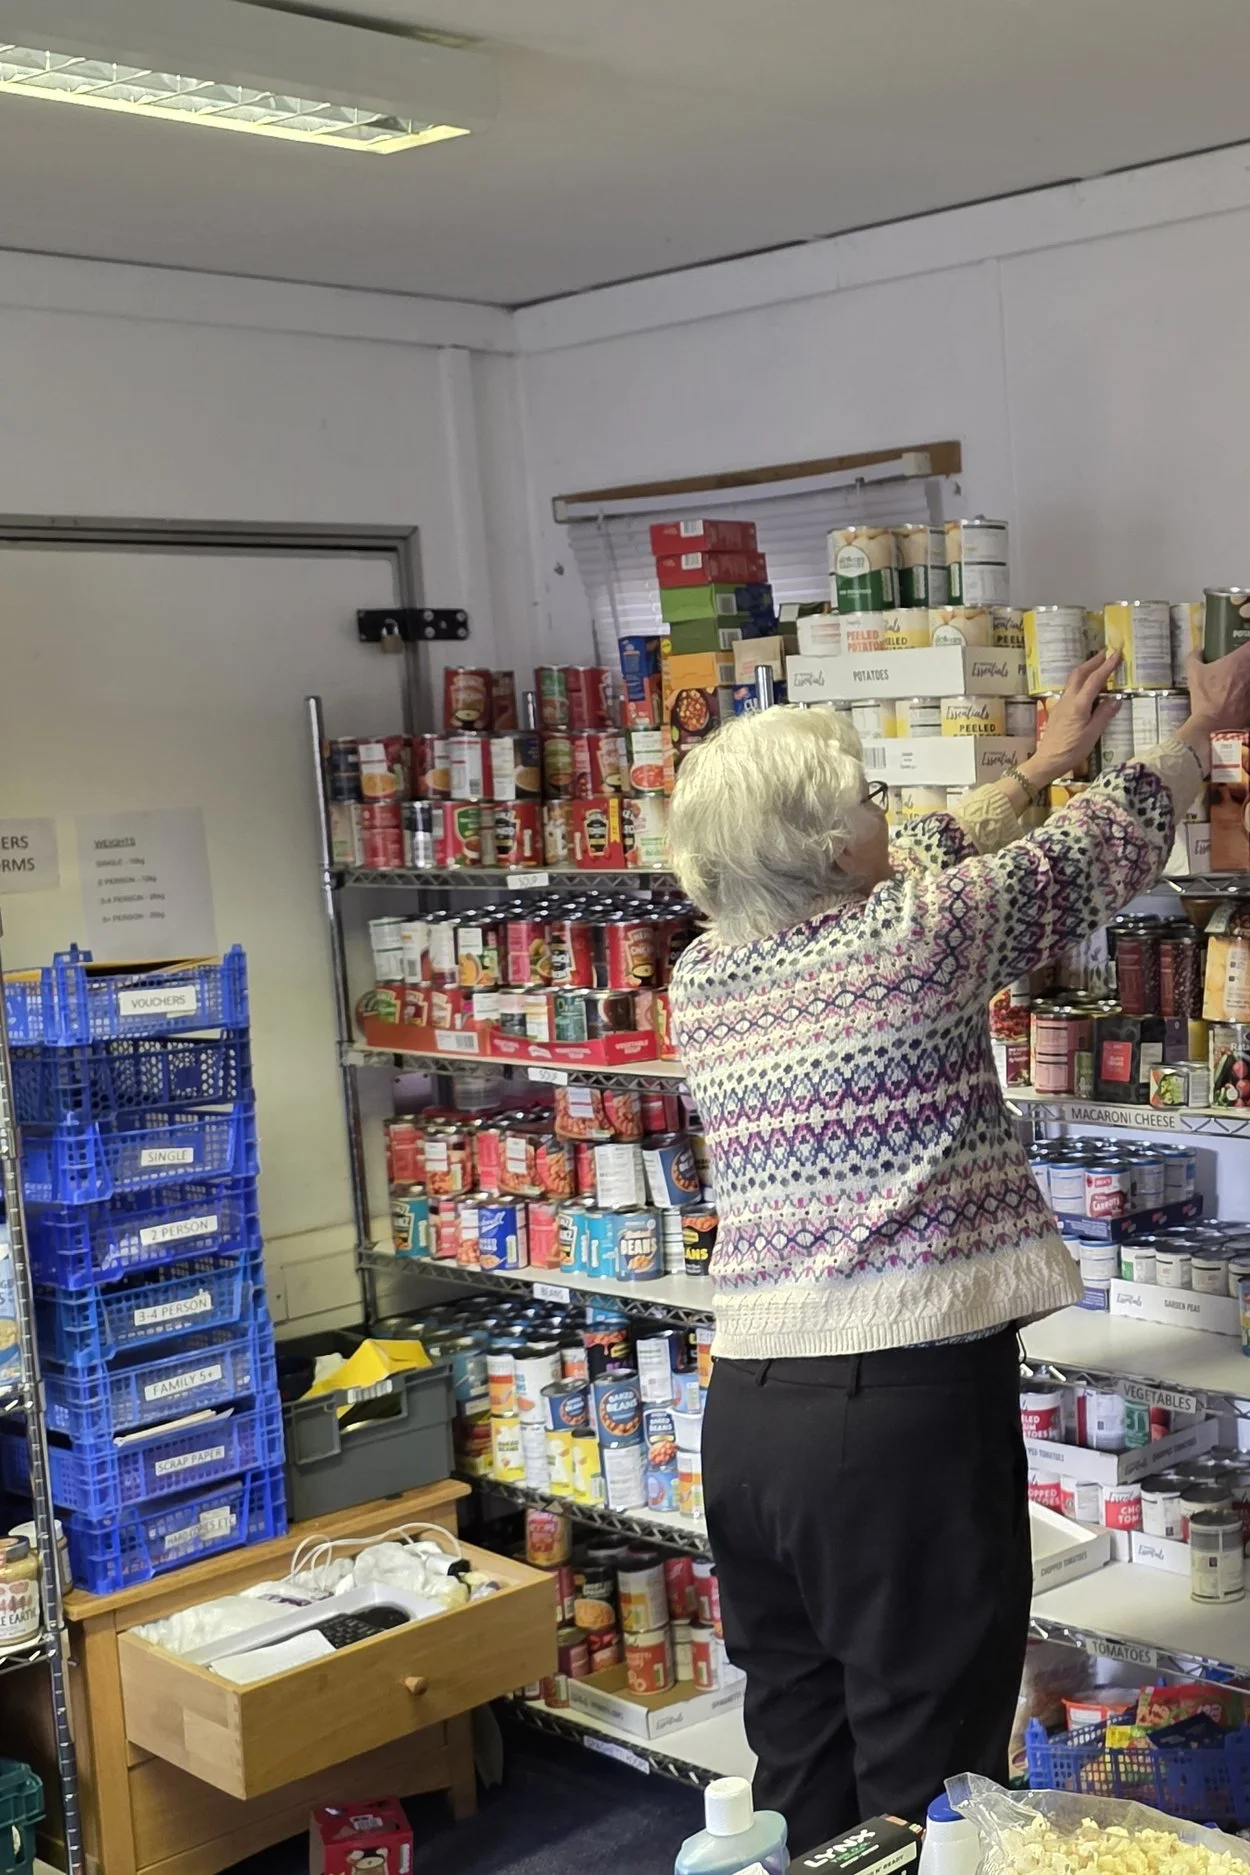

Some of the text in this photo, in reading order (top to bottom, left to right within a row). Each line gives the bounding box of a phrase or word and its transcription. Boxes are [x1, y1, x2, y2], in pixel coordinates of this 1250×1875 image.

[853, 670, 889, 682] POTATOES
[960, 724, 996, 733] PEELED
[0, 858, 35, 872] RMS
[131, 995, 186, 1010] VOUCHERS
[1072, 1108, 1175, 1128] MACARONI CHEESE
[148, 1151, 187, 1163] SINGLE
[152, 1220, 208, 1240] 2 PERSON
[138, 1299, 208, 1322] 3-4 PERSON
[152, 1371, 213, 1396] FAMILY 5+
[606, 1399, 637, 1412] BEANS
[1124, 1383, 1192, 1410] VEGETABLES
[158, 1447, 222, 1473] SCRAP PAPER
[168, 1533, 188, 1546] HARD
[1041, 1551, 1087, 1577] CHOPPED TOMATOES
[1092, 1640, 1152, 1662] TOMATOES
[803, 1829, 876, 1868] LYNX
